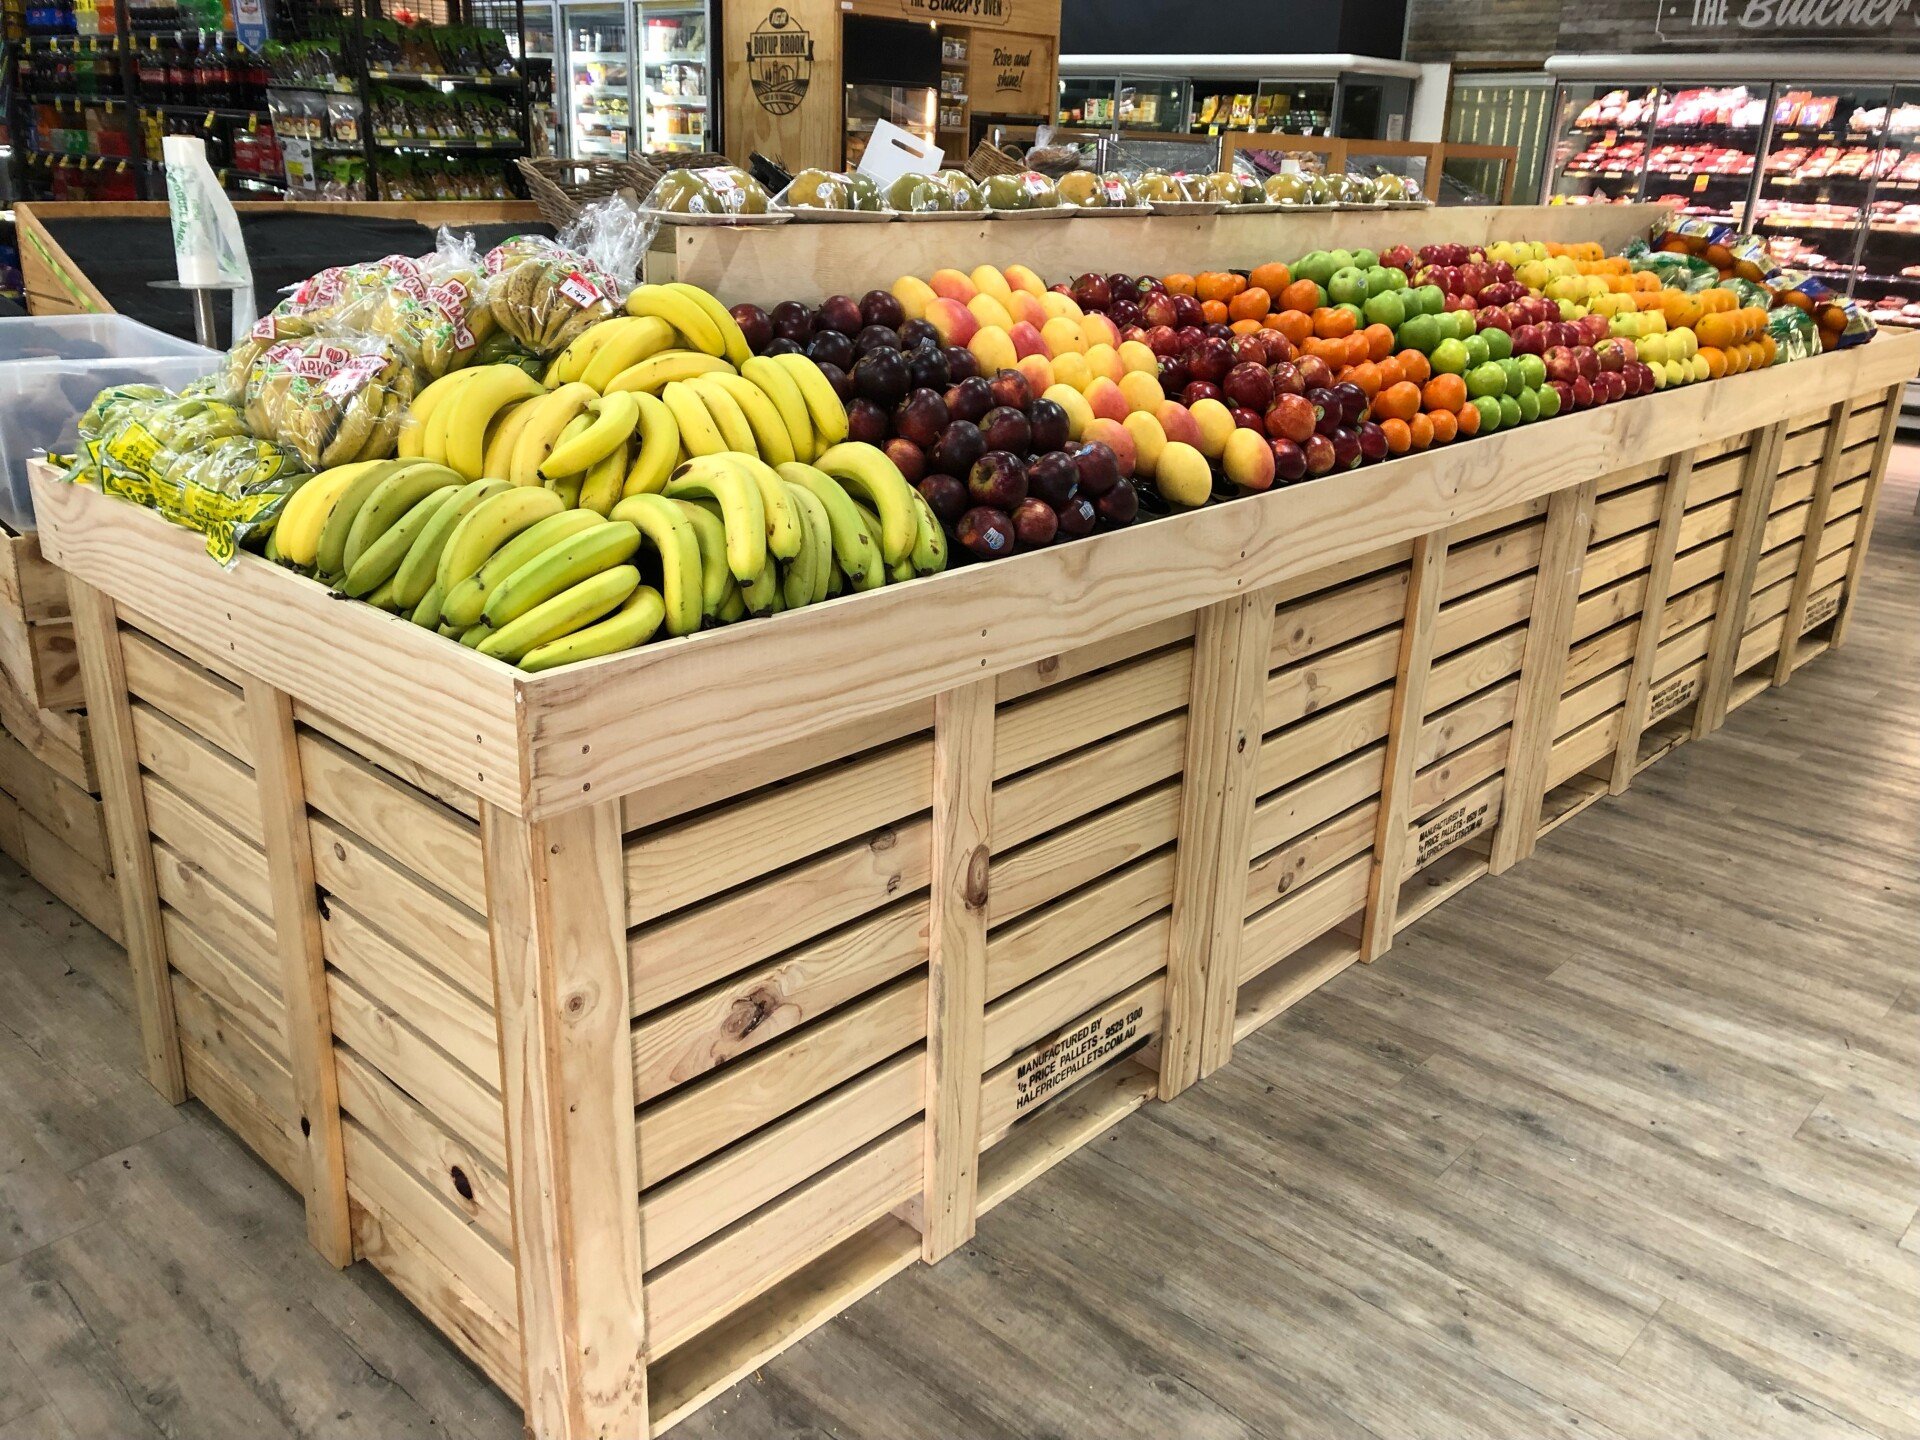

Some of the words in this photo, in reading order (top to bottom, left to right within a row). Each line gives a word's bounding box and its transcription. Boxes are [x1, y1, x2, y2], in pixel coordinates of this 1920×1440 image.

[1691, 0, 1728, 26] THE
[993, 46, 1012, 66] Rise
[1013, 49, 1032, 67] and
[1017, 1026, 1089, 1079] MANUFACTURED
[1090, 1017, 1103, 1034] BY
[1028, 1060, 1056, 1088] PRICE
[1059, 1035, 1098, 1068] PALLETS
